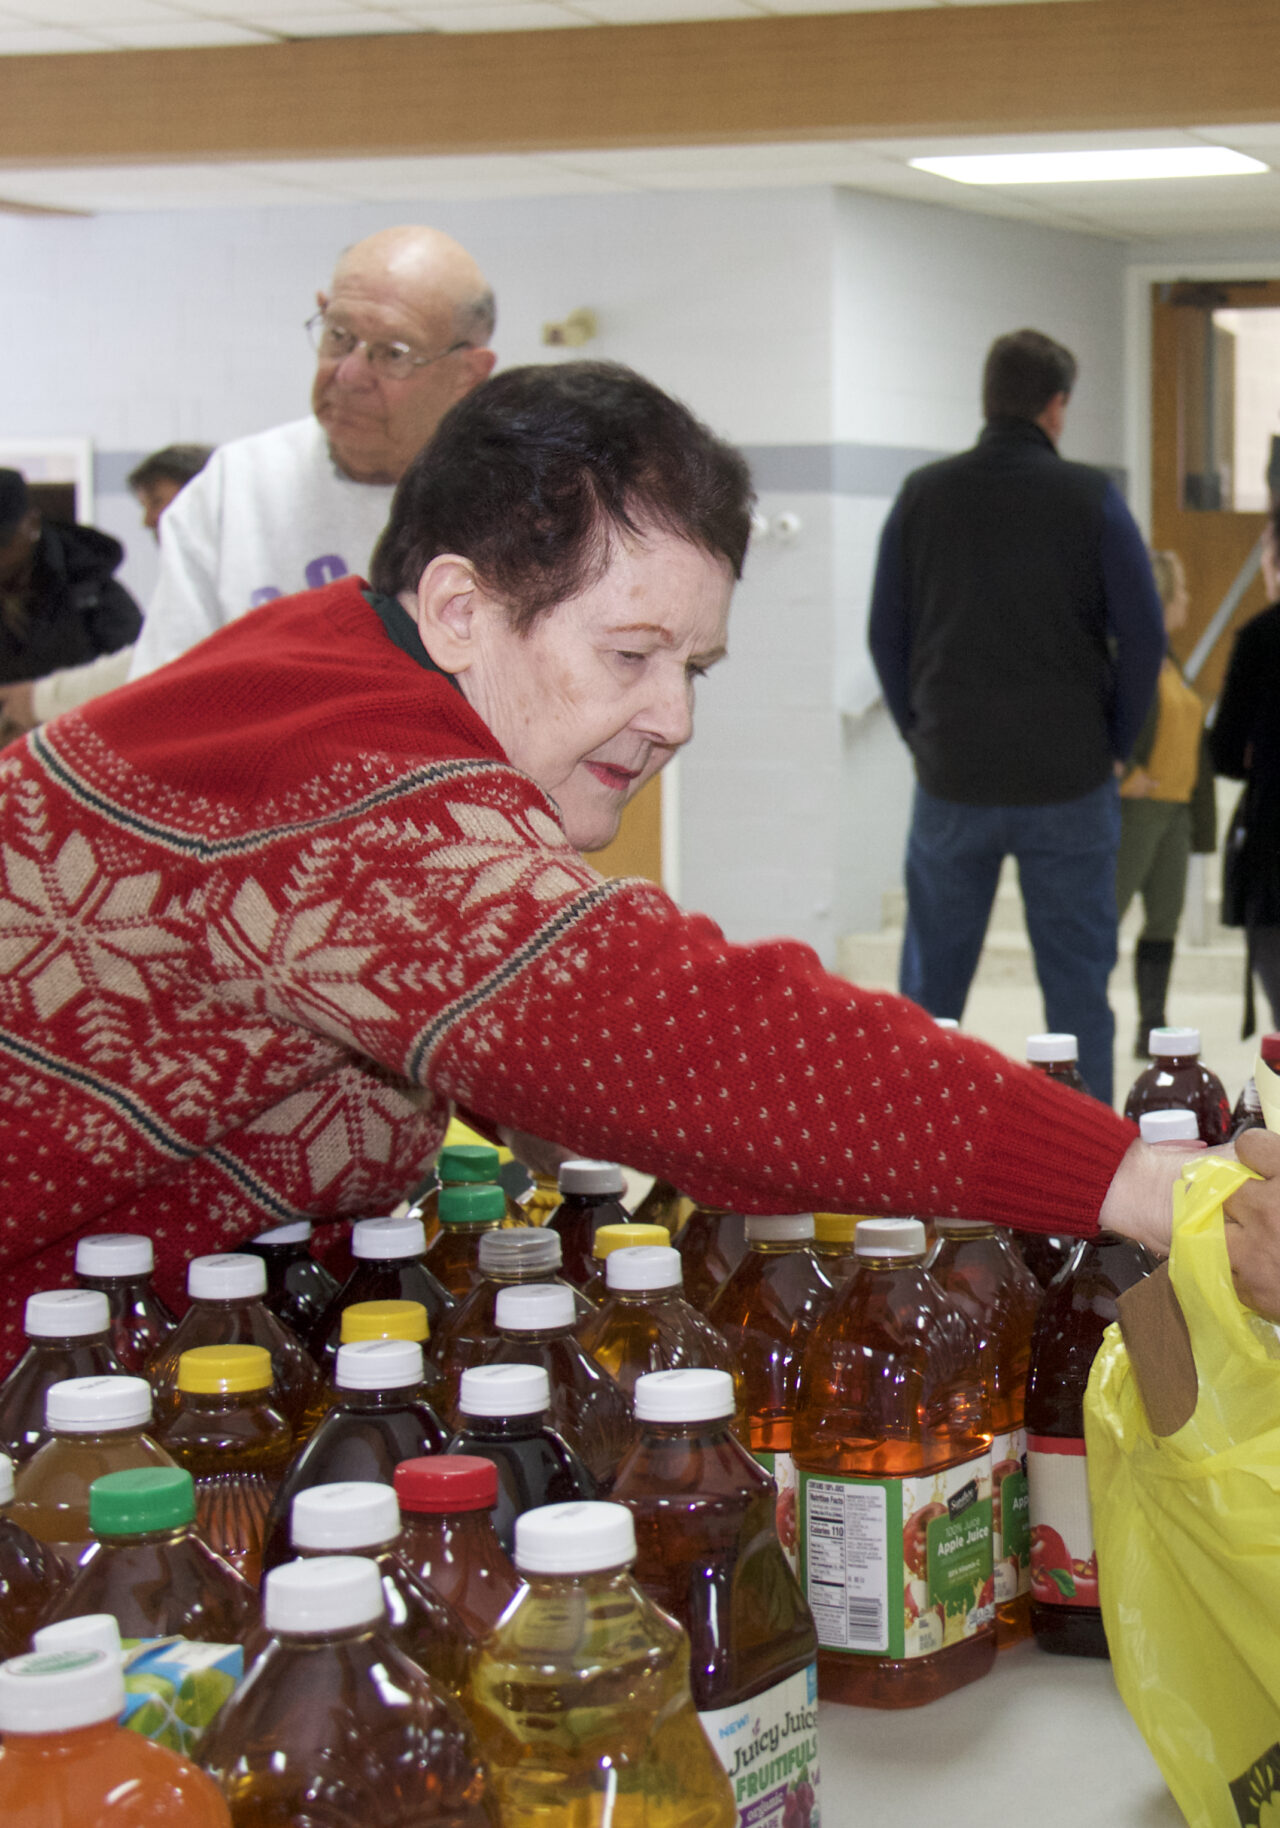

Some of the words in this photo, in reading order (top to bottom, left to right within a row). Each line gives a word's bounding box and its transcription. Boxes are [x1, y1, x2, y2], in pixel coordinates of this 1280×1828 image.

[810, 1493, 830, 1504] Nutrition
[831, 1495, 844, 1505] Facts
[810, 1525, 831, 1536] Calories
[832, 1526, 844, 1537] 110
[937, 1534, 965, 1557] Apple
[966, 1525, 989, 1545] Juice
[729, 1723, 779, 1777] Juicy
